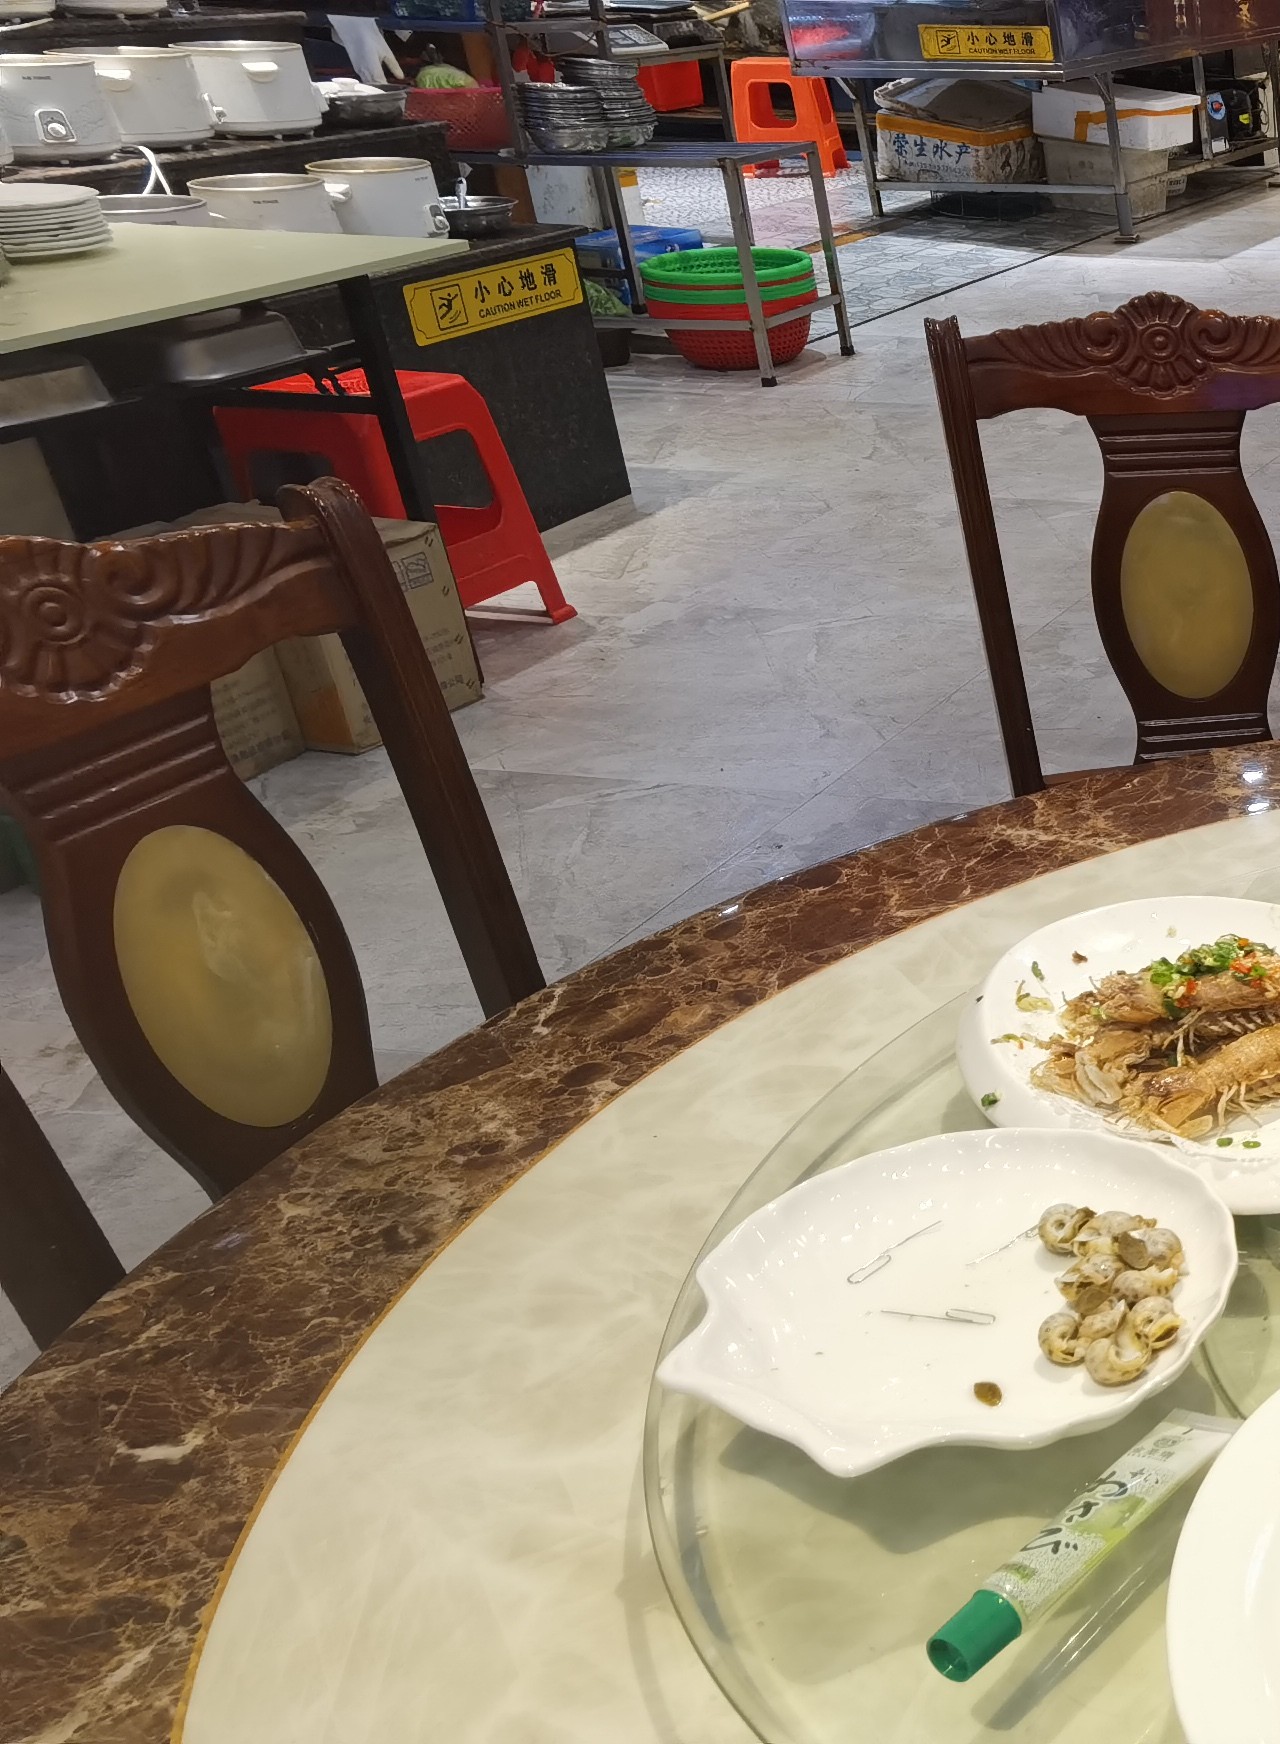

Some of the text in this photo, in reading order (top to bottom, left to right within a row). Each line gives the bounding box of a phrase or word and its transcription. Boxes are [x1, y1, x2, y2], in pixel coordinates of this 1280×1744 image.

[967, 31, 1034, 47] 小心地滑
[474, 263, 557, 304] 小心地滑
[478, 289, 562, 319] CAUTION WET FLOOR
